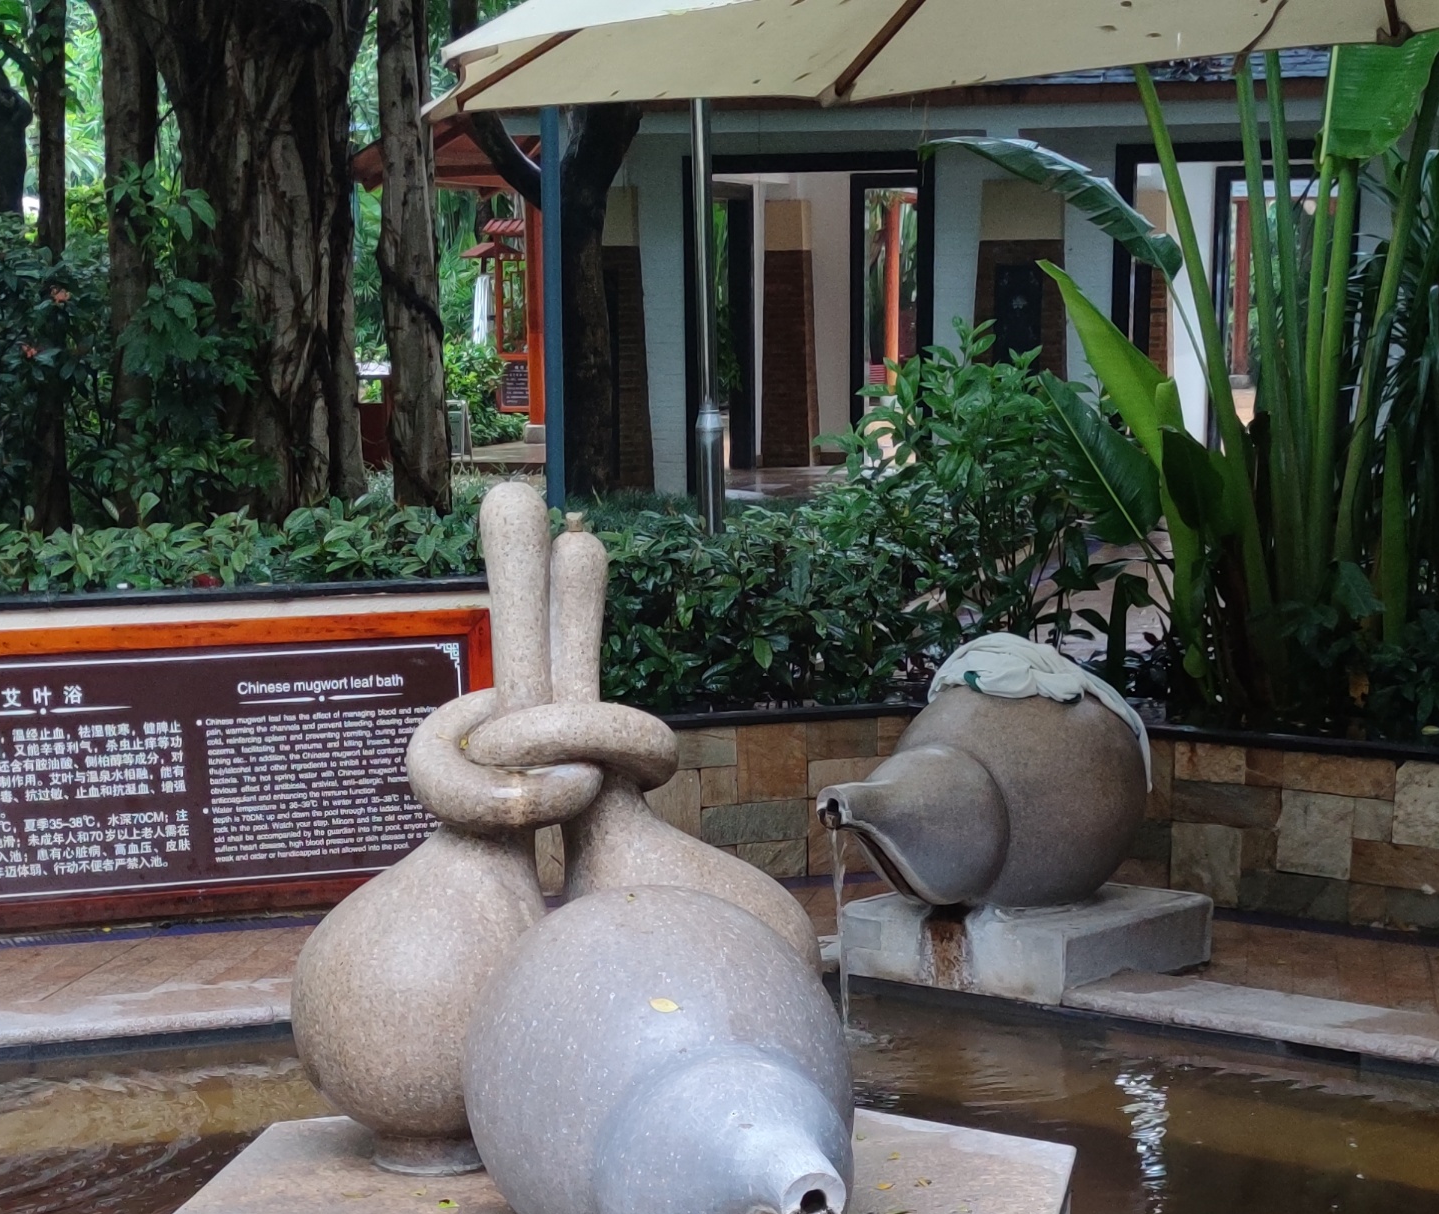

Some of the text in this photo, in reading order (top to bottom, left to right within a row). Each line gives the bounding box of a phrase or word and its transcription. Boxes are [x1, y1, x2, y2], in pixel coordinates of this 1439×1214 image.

[237, 673, 404, 695] Chinese mugwort leaf bath
[2, 685, 83, 708] 艾叶浴
[205, 717, 234, 726] Chinese
[236, 715, 266, 725] mugwort
[268, 714, 281, 722] leaf
[283, 713, 296, 721] has
[312, 711, 331, 719] effect
[332, 710, 339, 718] of
[342, 709, 375, 719] managing
[205, 727, 222, 737] pain,
[225, 726, 254, 736] warming
[269, 723, 300, 732] channels
[317, 721, 342, 730] prevent
[343, 719, 373, 729] bleeding,
[376, 717, 402, 726] clearing
[206, 737, 223, 746] cold,
[226, 735, 262, 745] reinforcing
[264, 733, 286, 743] spleen
[305, 731, 340, 741] preventing
[342, 729, 372, 738] vomiting,
[375, 728, 395, 736] curing
[241, 744, 275, 754] facilitating
[279, 743, 290, 751] the
[343, 739, 362, 748] killing
[366, 737, 390, 745] insects
[208, 757, 231, 766] itching
[258, 753, 286, 762] addition,
[289, 752, 300, 760] the
[301, 750, 330, 759] Chinese
[331, 749, 360, 758] mugwort
[376, 746, 404, 754] contains
[253, 764, 267, 772] and
[269, 763, 287, 771] other
[290, 760, 327, 771] ingredients
[339, 758, 359, 766] inhibit
[369, 757, 391, 765] variety
[209, 776, 238, 784] bacteria.
[242, 774, 256, 782] The
[274, 772, 295, 782] spring
[298, 771, 317, 779] water
[337, 767, 365, 776] Chinese
[368, 766, 397, 775] mugwort
[210, 786, 237, 794] obvious
[240, 784, 260, 792] effect
[263, 783, 270, 791] of
[311, 779, 338, 788] antiviral,
[342, 776, 383, 787] anti-allergic,
[211, 794, 256, 805] anticoagulant
[258, 793, 271, 801] and
[272, 791, 307, 801] enhancing
[349, 786, 375, 795] function
[211, 805, 232, 814] Water
[235, 803, 276, 813] temperature
[212, 815, 232, 825] depth
[276, 811, 289, 819] and
[291, 810, 309, 818] down
[324, 808, 338, 817] pool
[339, 807, 365, 816] through
[213, 835, 224, 843] old
[226, 834, 243, 842] shall
[256, 830, 301, 840] accompanied
[303, 830, 311, 838] by
[313, 828, 324, 836] the
[326, 826, 355, 836] guardian
[403, 822, 427, 830] anyone
[252, 823, 269, 831] pool.
[271, 821, 293, 829] Watch
[296, 821, 310, 829] your
[313, 819, 329, 827] step.
[331, 817, 354, 825] Minors
[214, 844, 238, 852] suffers
[239, 843, 257, 851] heart
[288, 839, 303, 848] high
[305, 837, 324, 846] blood
[325, 837, 354, 845] pressure
[380, 832, 405, 840] disease
[215, 854, 233, 862] weak
[235, 853, 248, 861] and
[277, 848, 320, 858] handicapped
[341, 845, 366, 853] allowed
[393, 841, 409, 850] pool.
